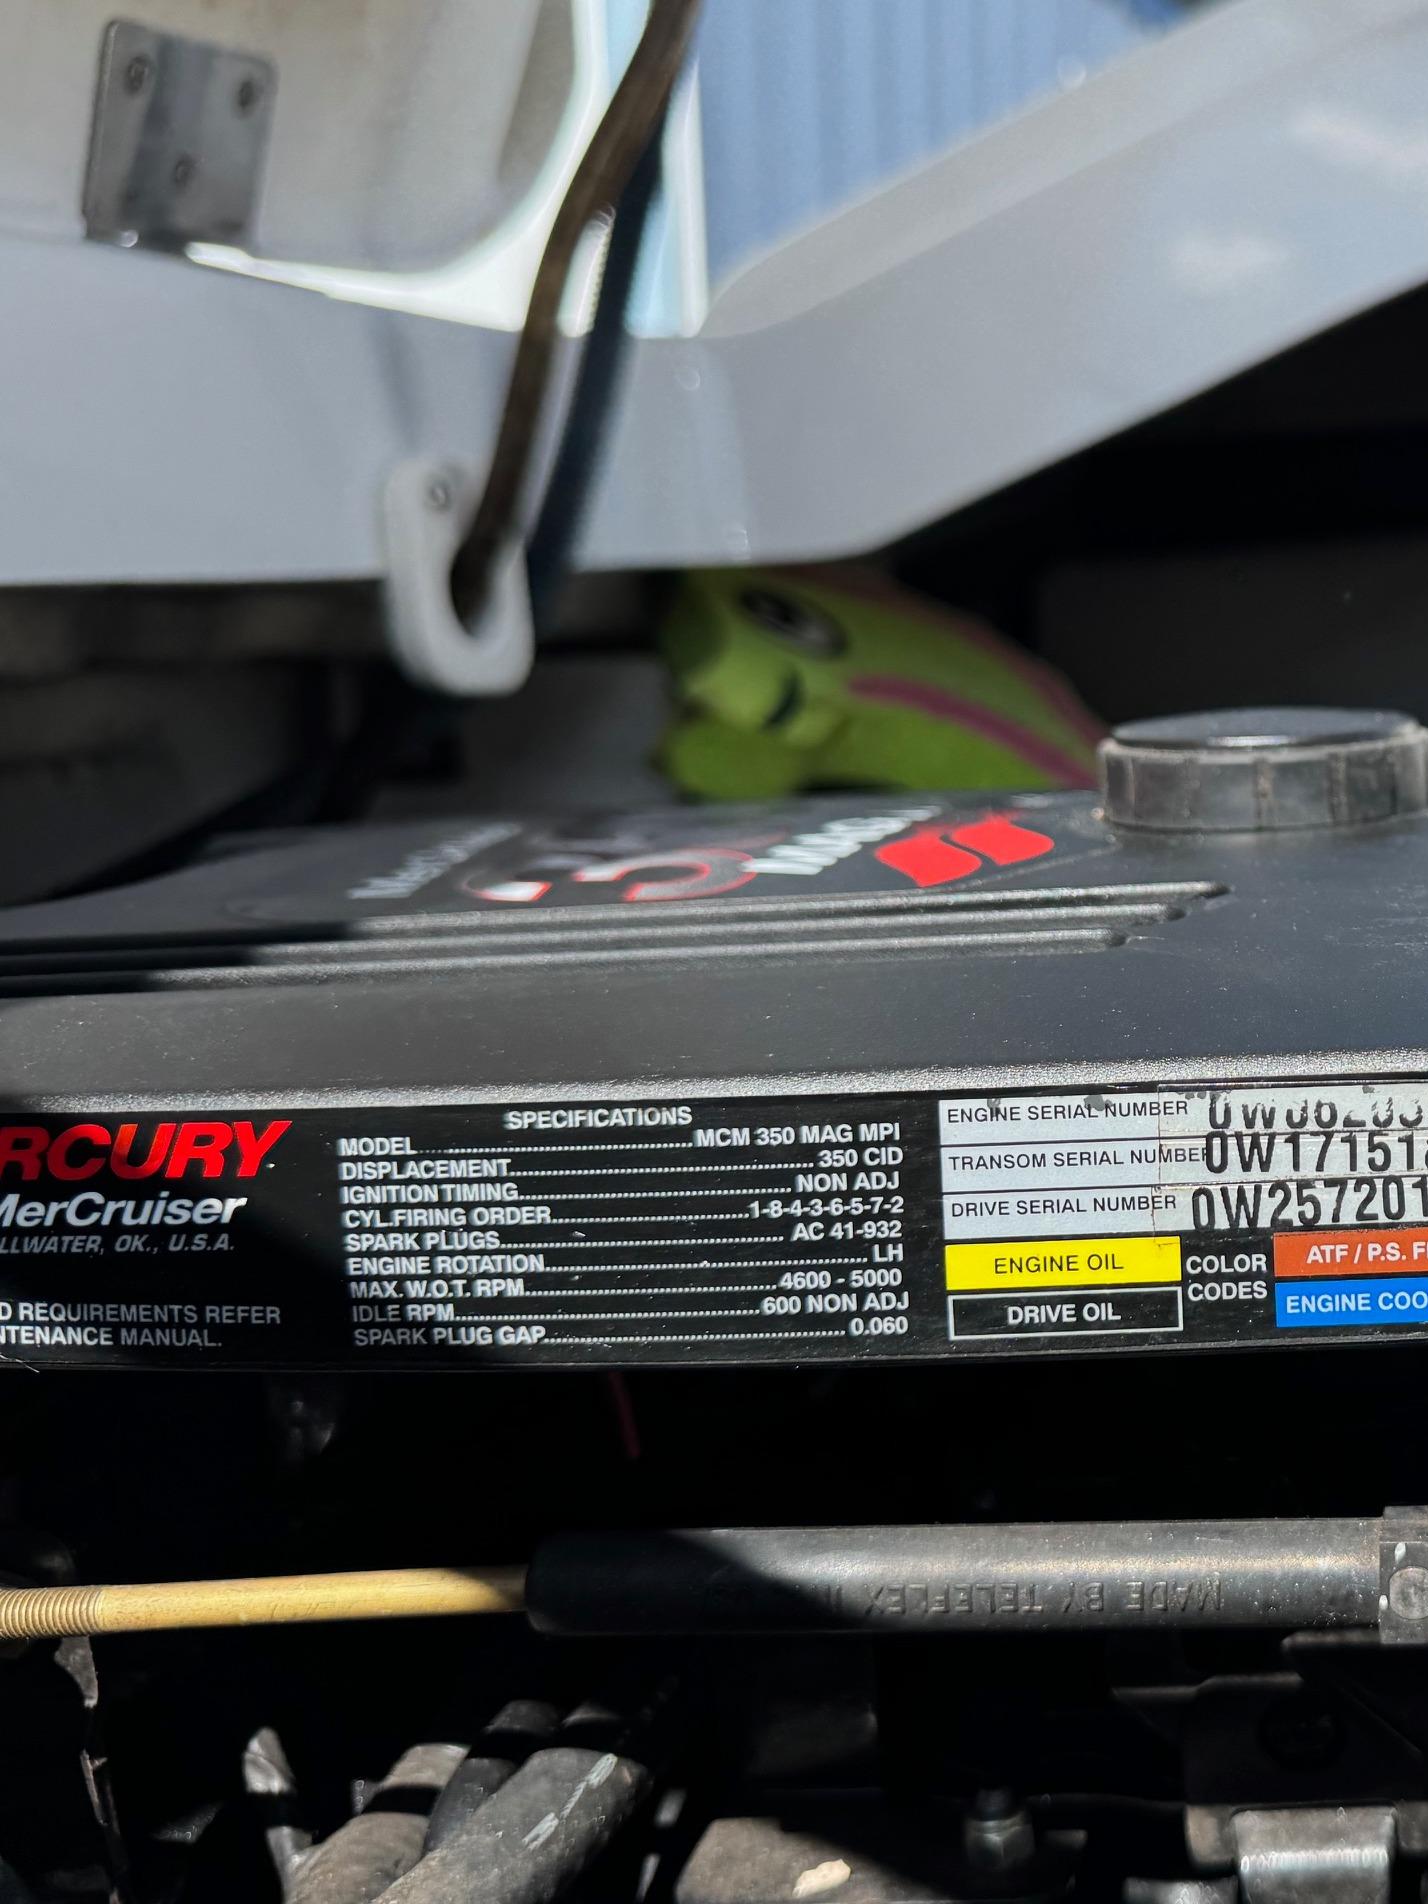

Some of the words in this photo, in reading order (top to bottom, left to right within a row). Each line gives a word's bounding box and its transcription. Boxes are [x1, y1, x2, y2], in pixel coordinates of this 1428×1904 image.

[503, 1106, 693, 1129] SPECIFICATIONS
[947, 1107, 1021, 1123] ENGINE
[1027, 1103, 1099, 1121] SERIAL
[1104, 1101, 1188, 1117] NUMBER
[694, 1129, 750, 1146] MCM
[754, 1127, 795, 1145] 350
[800, 1124, 853, 1143] MAG
[859, 1122, 900, 1141] MPI
[339, 1158, 511, 1180] DISPLACEMENT
[817, 1150, 857, 1167] 350
[863, 1147, 903, 1166] CID
[949, 1153, 1046, 1171] TRANSOM
[1053, 1150, 1124, 1167] SERIAL
[340, 1184, 438, 1204] IGNITION
[442, 1182, 519, 1201] TIMING
[795, 1174, 848, 1192] NON
[853, 1171, 900, 1190] ADJ
[469, 1206, 551, 1225] ORDER
[748, 1195, 905, 1219] 1-8-4-3-6-5-7-2
[951, 1200, 1010, 1217] DRIVE
[1016, 1198, 1088, 1215] SERIAL
[1093, 1194, 1177, 1211] NUMBER
[169, 1233, 235, 1251] U.S.A.
[344, 1232, 420, 1252] SPARK
[423, 1231, 500, 1250] PLUGS
[790, 1222, 824, 1241] AC
[828, 1220, 902, 1239] 41-932
[346, 1256, 430, 1275] ENGINE
[433, 1254, 545, 1274] ROTATION
[872, 1243, 904, 1262] LH
[994, 1256, 1079, 1275] ENGINE
[1087, 1253, 1124, 1270] OIL
[1307, 1244, 1349, 1264] ATF
[1367, 1240, 1407, 1261] P.S.
[1186, 1254, 1268, 1275] COLOR
[350, 1281, 404, 1298] MAX.
[404, 1279, 471, 1297] W.O.T.
[473, 1278, 524, 1297] RPM
[778, 1271, 831, 1290] 4600
[850, 1269, 903, 1288] 5000
[1187, 1281, 1268, 1302] CODES
[18, 1302, 198, 1323] REQUIREMENTS
[205, 1305, 281, 1324] REFER
[353, 1304, 401, 1322] IDLE
[405, 1303, 455, 1322] RPM
[760, 1297, 801, 1315] 600
[805, 1294, 857, 1313] NON
[862, 1291, 910, 1311] ADJ
[1007, 1305, 1077, 1325] DRIVE
[1082, 1303, 1121, 1321] OIL
[1286, 1294, 1371, 1314] ENGINE
[121, 1327, 223, 1347] MANUAL.
[354, 1328, 427, 1347] SPARK
[433, 1327, 492, 1345] PLUG
[495, 1325, 546, 1345] GAP
[850, 1316, 909, 1336] 0.060
[864, 1582, 1043, 1617] TELEFLEX
[1062, 1581, 1104, 1613] BY
[1125, 1580, 1222, 1613] MADE
